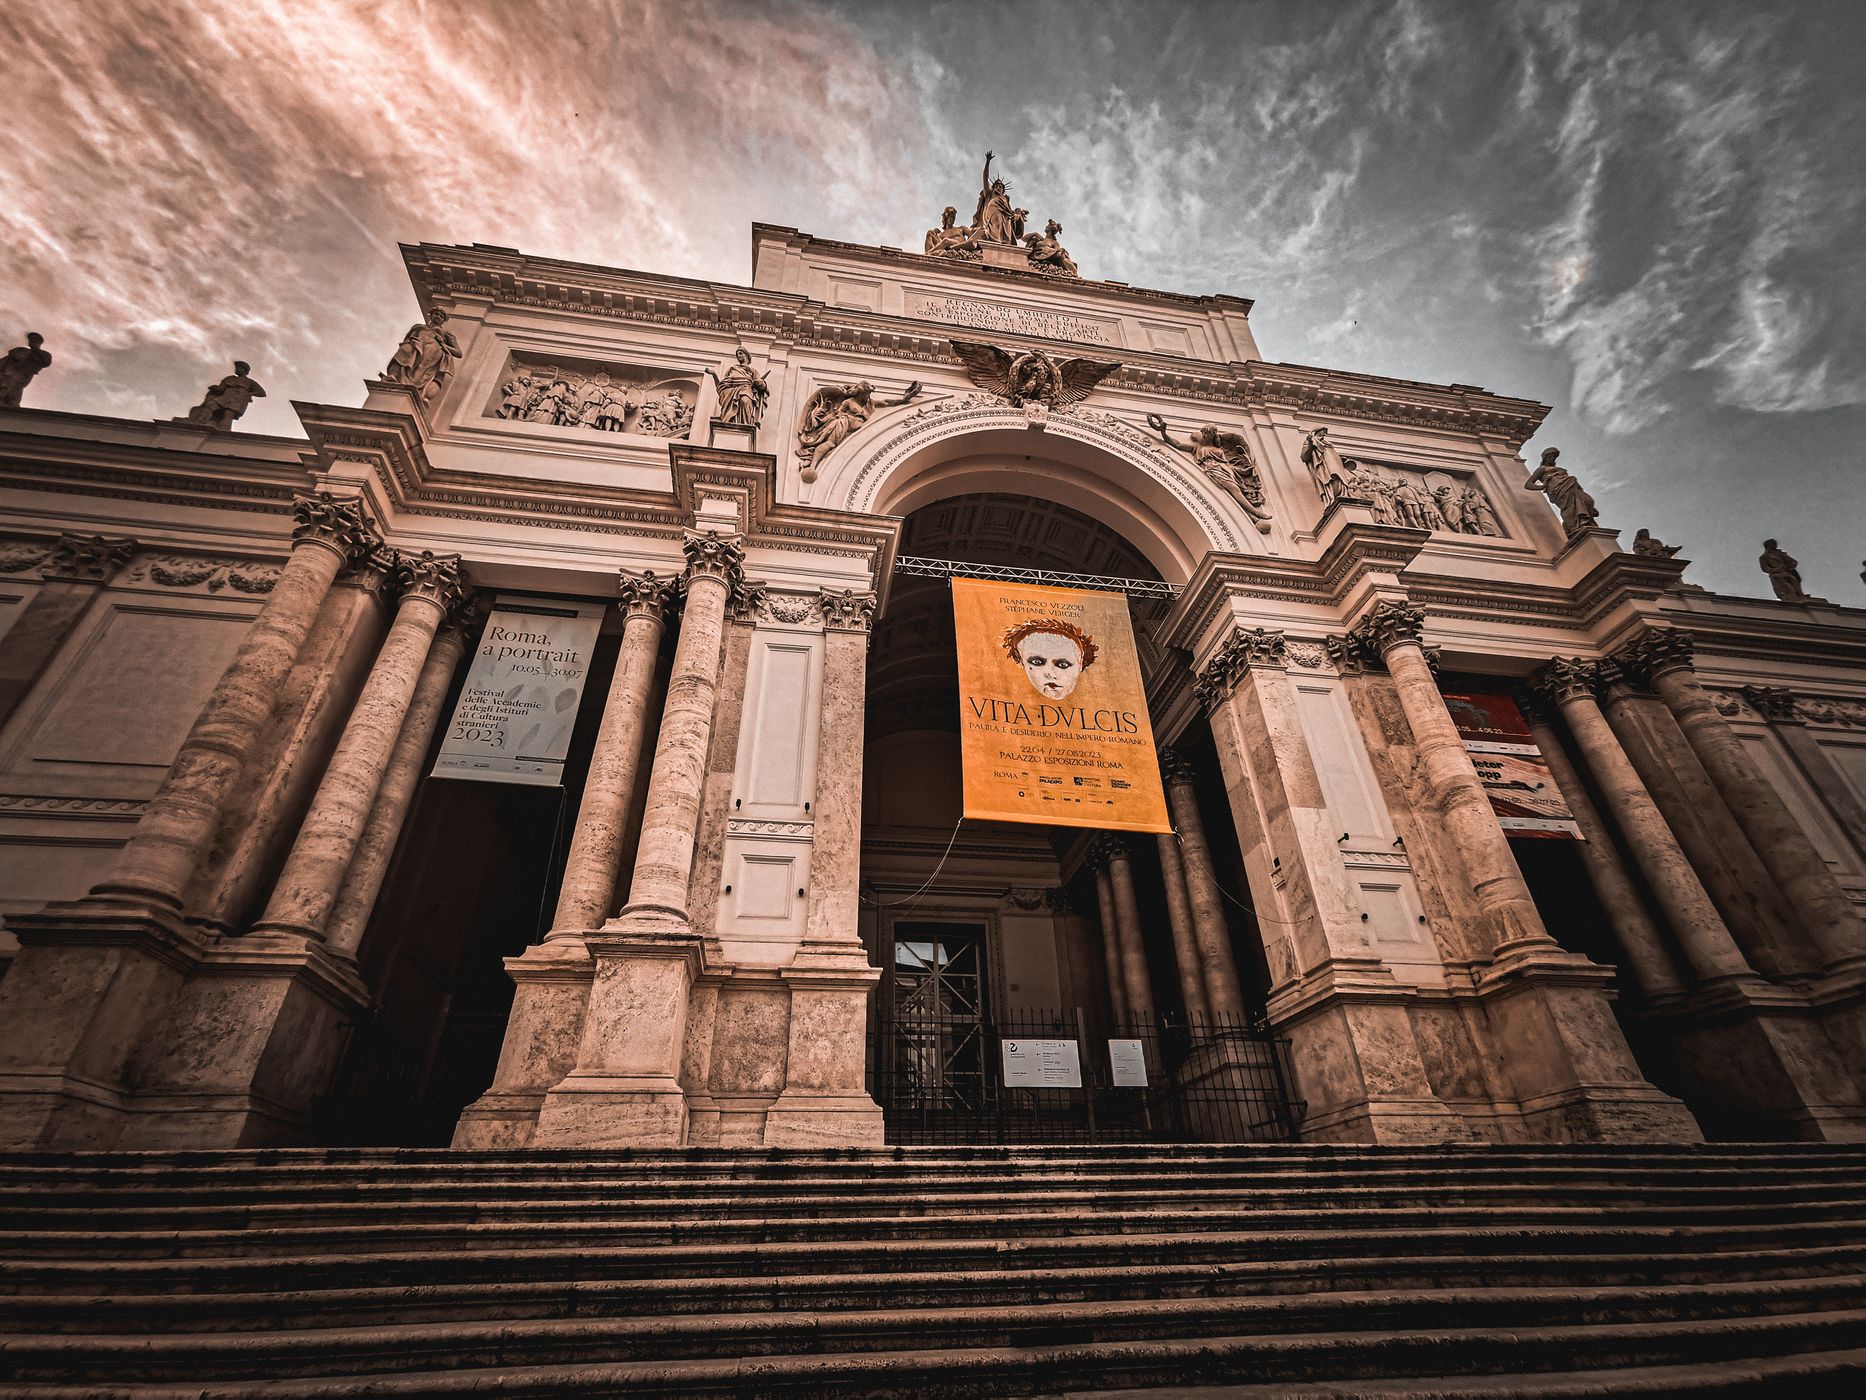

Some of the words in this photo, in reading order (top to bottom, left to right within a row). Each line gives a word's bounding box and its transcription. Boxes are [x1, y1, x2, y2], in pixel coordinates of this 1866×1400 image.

[945, 305, 991, 314] COMUNE
[1019, 315, 1048, 323] ROMA
[946, 300, 1010, 312] REGNANDO
[1016, 310, 1070, 322] UMBERTO
[917, 310, 998, 326] CONTRIBUENDO
[1004, 323, 1037, 331] STATO
[1056, 330, 1110, 342] PROVINCIA
[948, 310, 1014, 323] ESPOSIZIONE
[1038, 322, 1066, 331] BELLE
[1000, 598, 1047, 608] FRANCESCO
[1050, 602, 1084, 612] VEZZOLI
[1048, 609, 1080, 618] VERGER
[490, 626, 551, 646] Roma,
[483, 646, 493, 656] a
[498, 646, 579, 663] portrait
[468, 688, 504, 698] Festival
[465, 696, 488, 704] delle
[490, 698, 542, 709] Accademie
[470, 705, 494, 713] degli
[496, 706, 529, 716] Istituti
[471, 712, 508, 722] Cultura
[968, 697, 1033, 725] VITA
[1038, 704, 1137, 734] DVLCIS
[456, 720, 499, 729] stranieri
[452, 728, 504, 747] 2023
[969, 722, 999, 732] PAURA
[1010, 728, 1052, 738] DESIDERIO
[1108, 736, 1146, 746] ROMANO
[1000, 752, 1041, 763] PALAZZO
[1044, 757, 1094, 767] ESPOSIZIONI
[1097, 761, 1124, 769] ROMA
